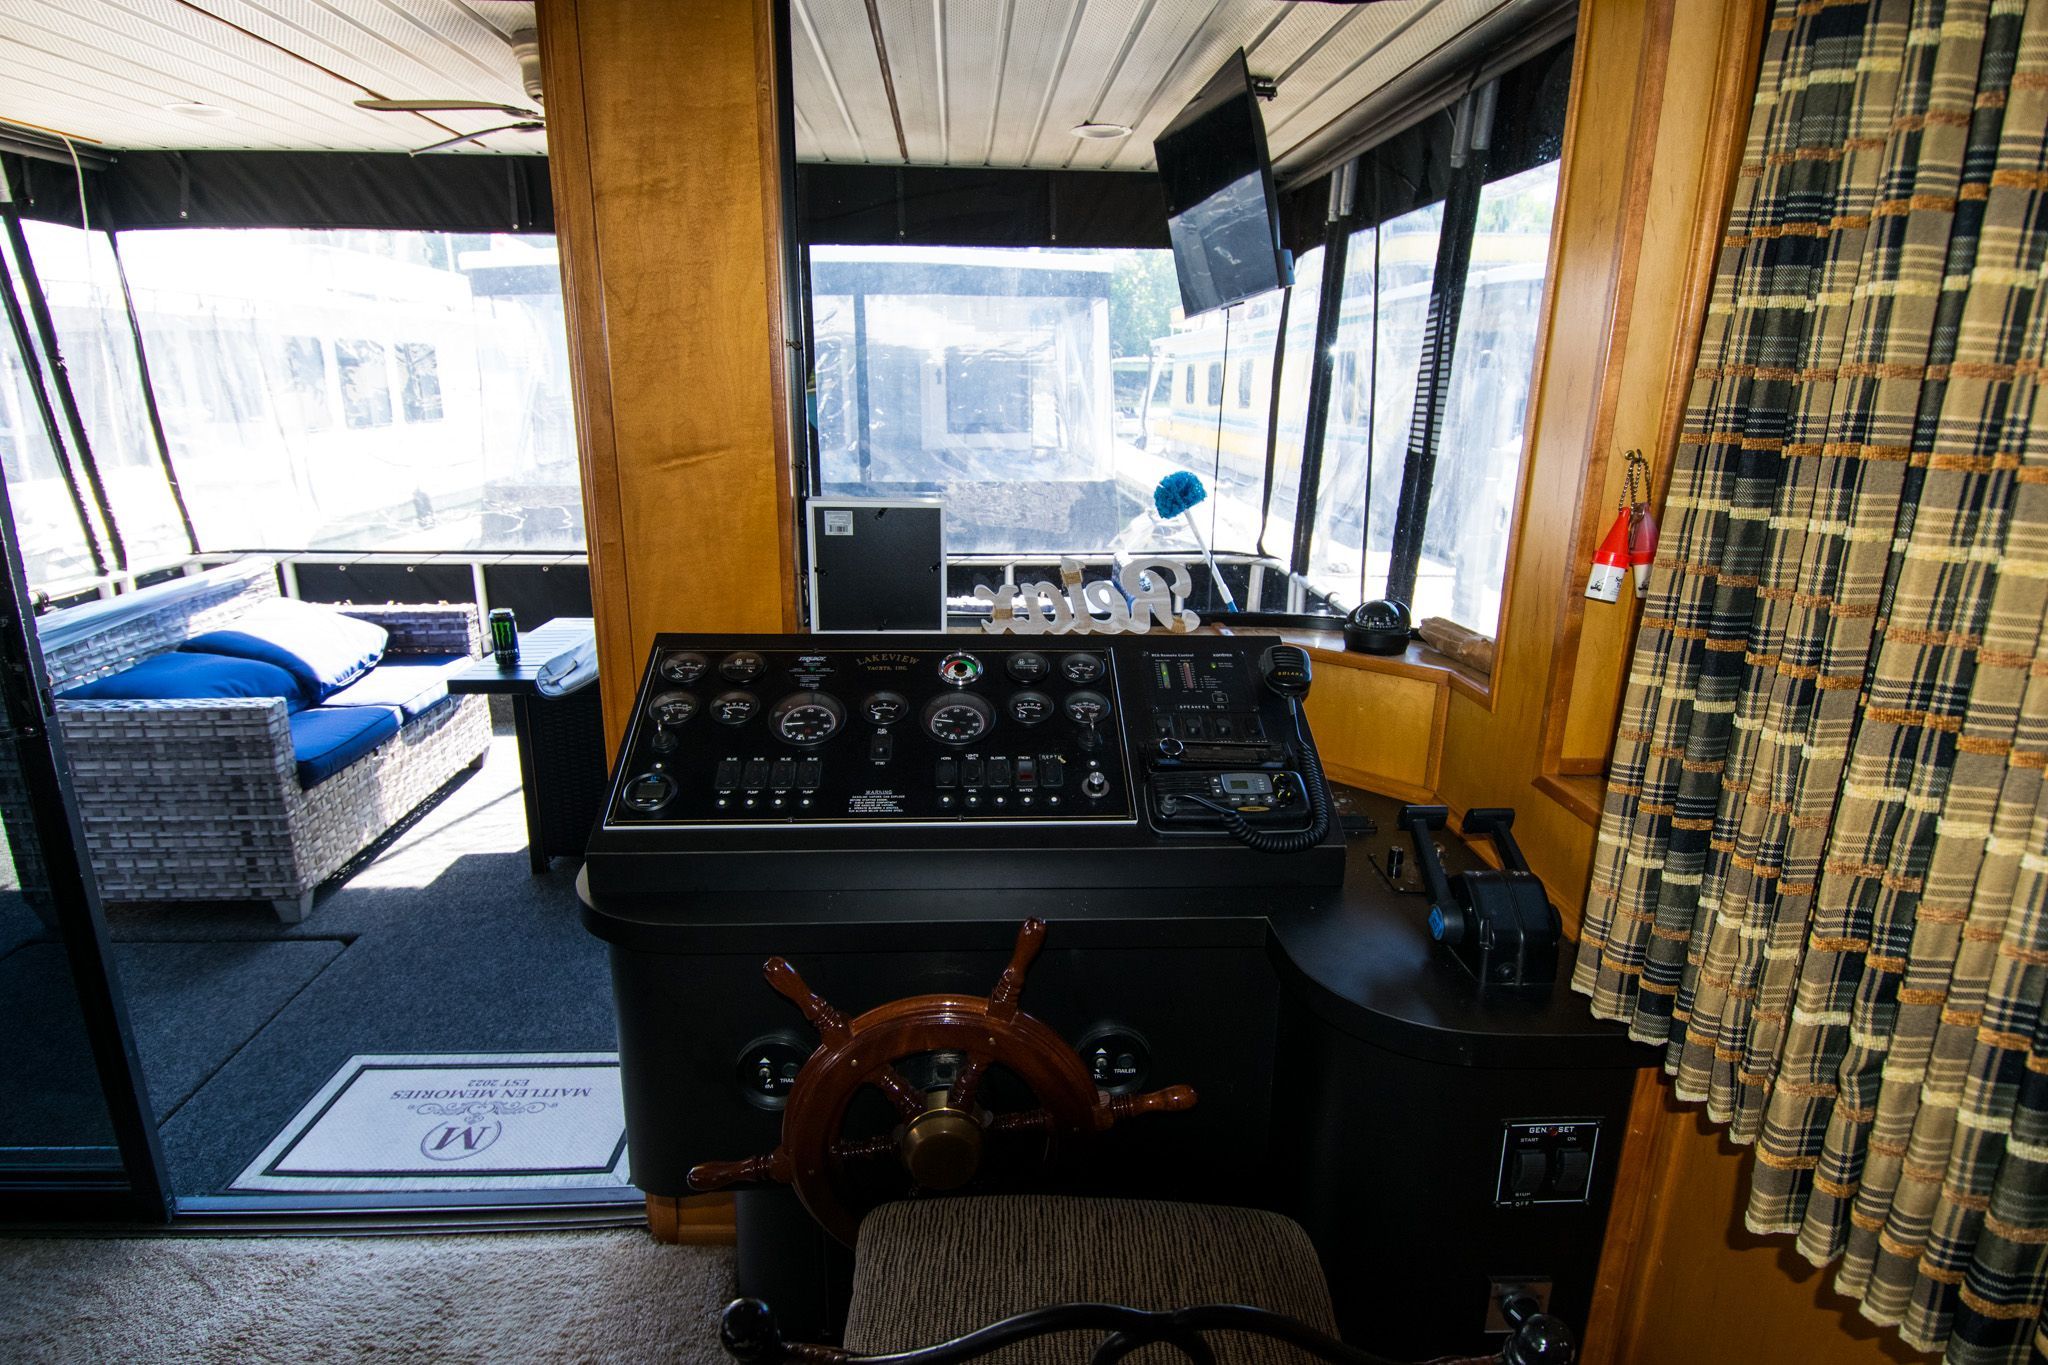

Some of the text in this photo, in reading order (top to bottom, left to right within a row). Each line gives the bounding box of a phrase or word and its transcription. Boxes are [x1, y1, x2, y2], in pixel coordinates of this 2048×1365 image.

[856, 653, 920, 666] LAKEVIEW
[467, 1079, 530, 1087] EST 2022
[390, 1087, 591, 1100] MAITLEN MEMORIES
[1528, 1125, 1576, 1134] GEN SET
[430, 1126, 492, 1151] M
